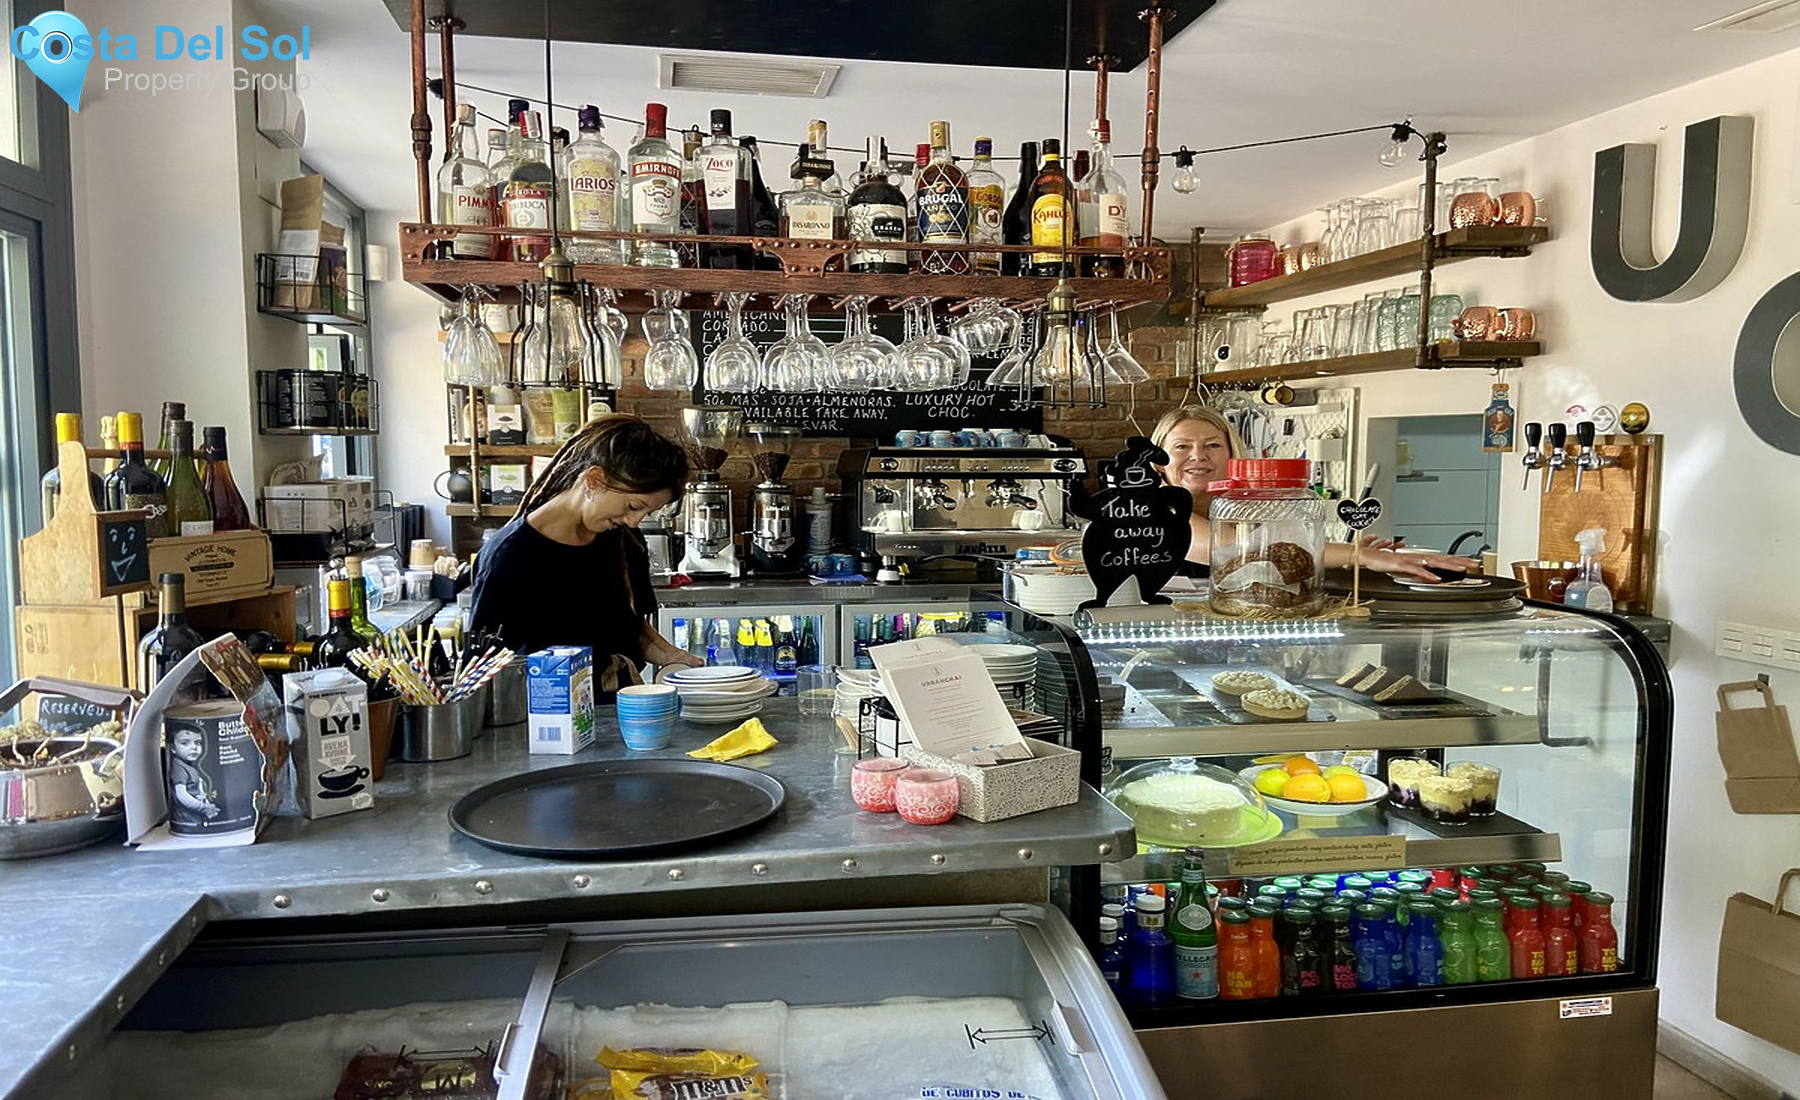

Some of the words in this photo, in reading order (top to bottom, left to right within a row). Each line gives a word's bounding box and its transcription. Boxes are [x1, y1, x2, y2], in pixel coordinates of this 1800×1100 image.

[634, 164, 681, 179] SMIRNOFF
[919, 193, 963, 206] BRUGAL
[1108, 205, 1128, 218] DY
[730, 395, 759, 406] MAS
[905, 394, 965, 406] LUXURY
[966, 394, 996, 407] HOT
[815, 407, 849, 419] TAKE
[1101, 496, 1151, 518] Take
[1114, 526, 1164, 548] away
[216, 544, 237, 558] HOME
[1100, 547, 1172, 567] Coffees
[320, 712, 361, 737] LY!
